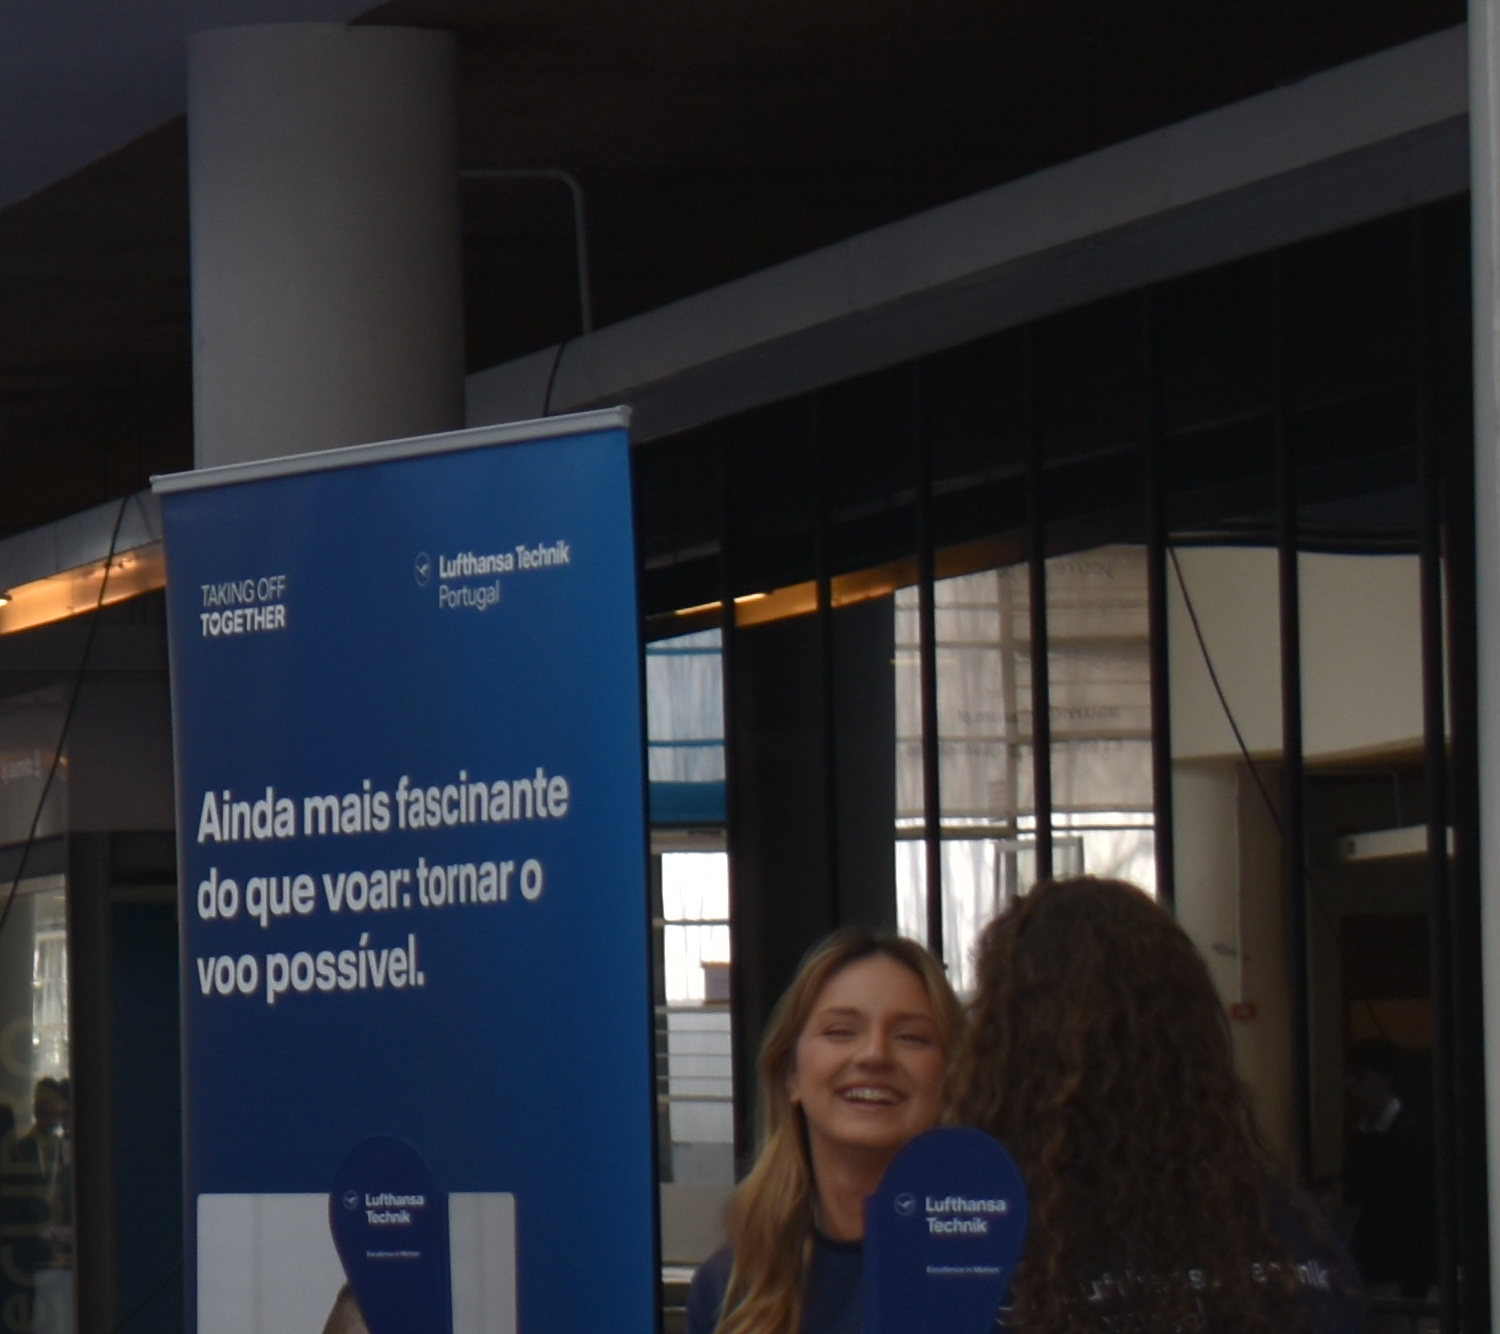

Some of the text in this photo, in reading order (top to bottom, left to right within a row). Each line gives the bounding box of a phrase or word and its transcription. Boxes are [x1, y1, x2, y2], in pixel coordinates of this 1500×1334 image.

[439, 540, 570, 579] Lufthansa Technik
[201, 575, 286, 607] TAKING OFF
[439, 580, 501, 612] Portugal
[201, 604, 286, 636] TOGETHER
[197, 767, 570, 843] Ainda mais fascinante
[197, 857, 544, 927] do que voar: tornar o
[196, 932, 425, 1005] voo possível.
[365, 1193, 425, 1207] Lufthansa
[365, 1209, 411, 1223] Technik
[925, 1195, 1008, 1212] Lufthansa
[926, 1216, 988, 1233] Technik
